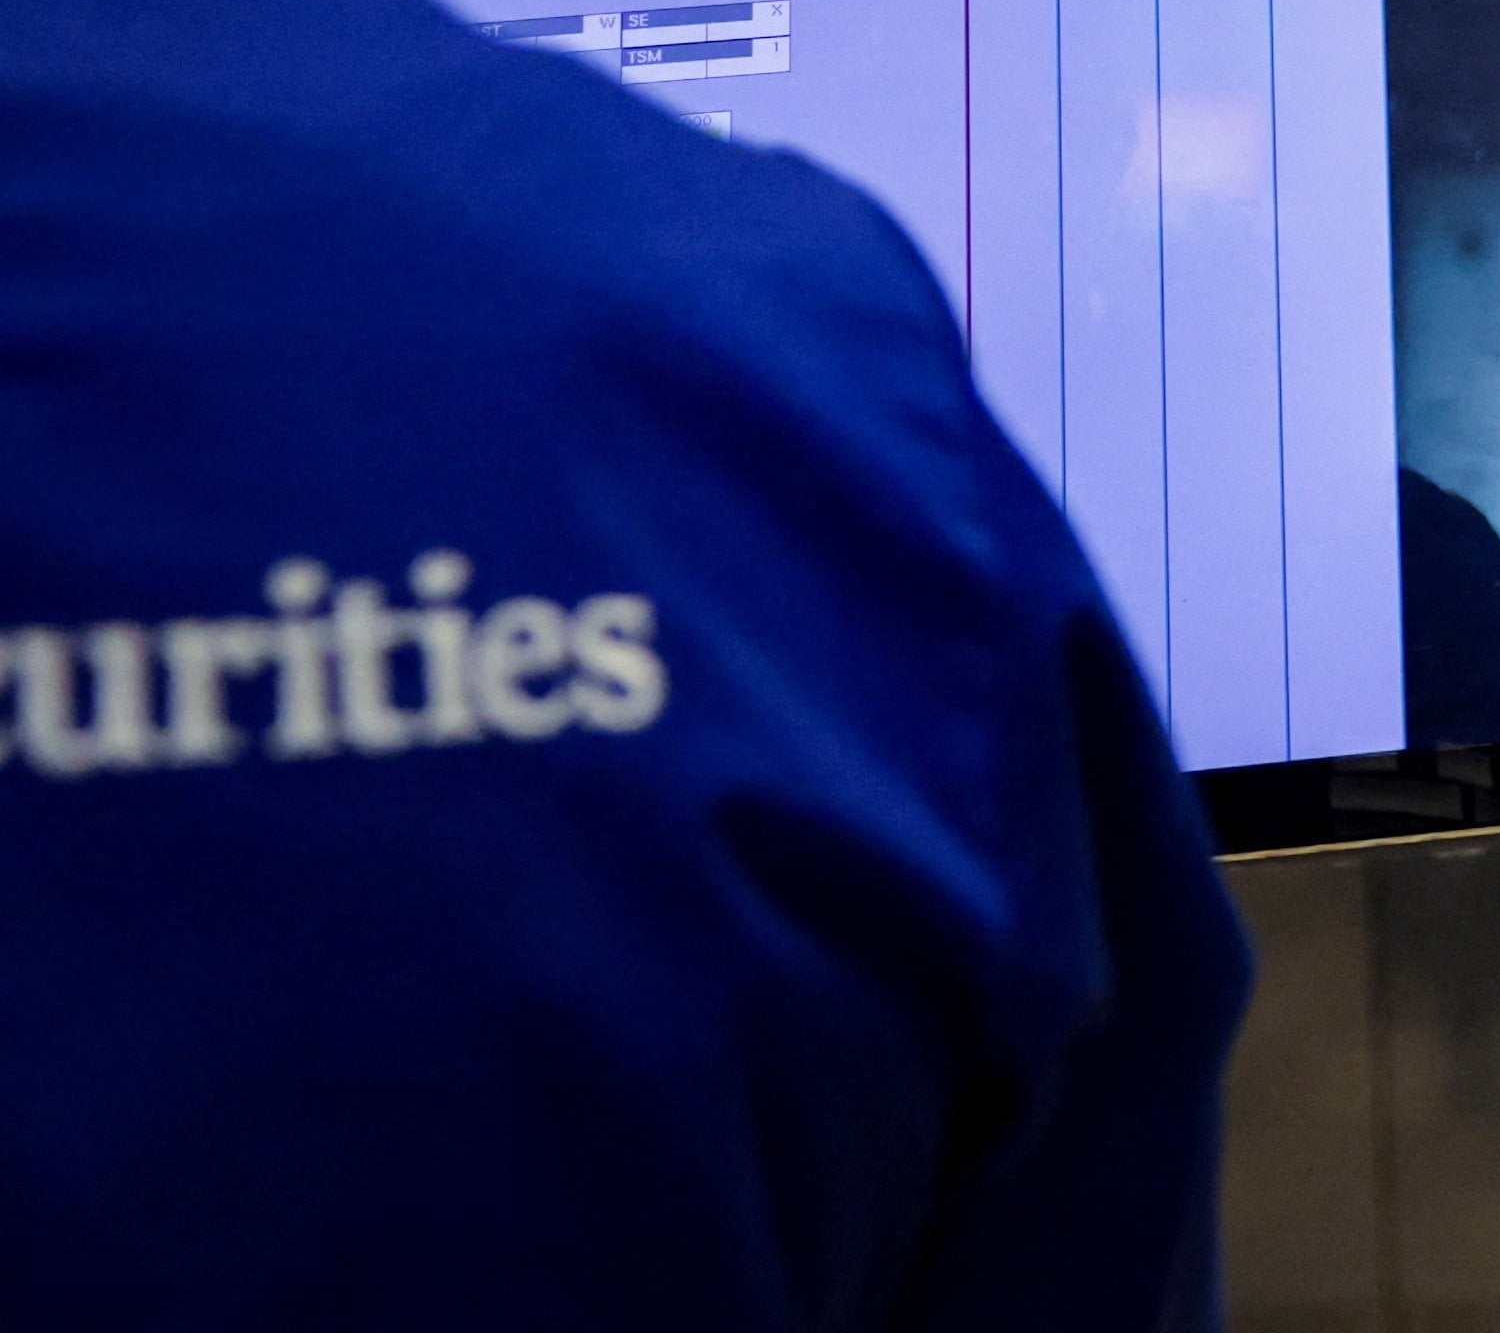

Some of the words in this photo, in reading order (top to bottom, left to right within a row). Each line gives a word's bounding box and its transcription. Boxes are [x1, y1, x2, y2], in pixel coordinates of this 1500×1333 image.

[599, 16, 617, 29] W
[628, 14, 649, 28] SE
[628, 50, 662, 64] TSM
